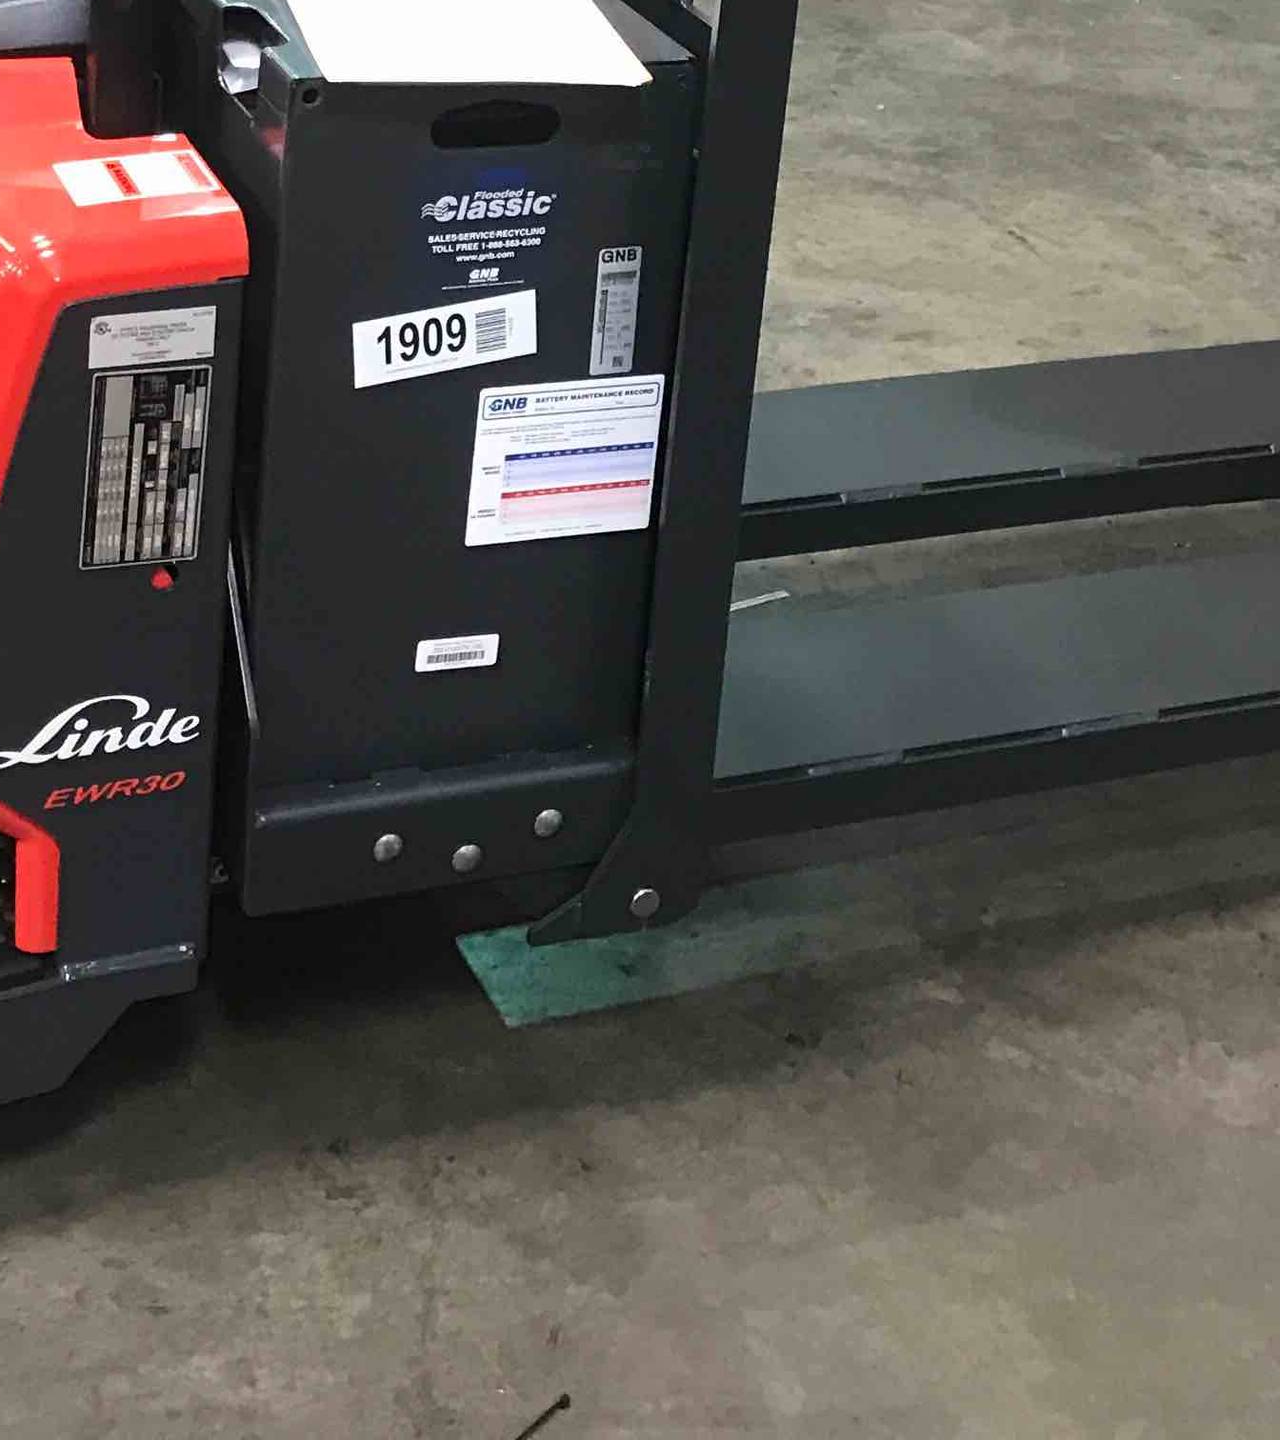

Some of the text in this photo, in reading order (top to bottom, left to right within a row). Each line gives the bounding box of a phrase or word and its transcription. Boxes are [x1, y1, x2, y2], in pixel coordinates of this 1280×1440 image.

[473, 188, 525, 201] Flooded
[433, 190, 553, 222] Classic
[431, 244, 455, 254] TOLL
[455, 242, 480, 252] FREE
[601, 248, 638, 263] GNB
[455, 251, 516, 262] www.gnb.com
[468, 267, 500, 280] GNB
[376, 312, 468, 365] 1909
[488, 388, 655, 413] GNB BATTERY MAINTENANCE RECORD
[43, 770, 187, 810] EWR30
